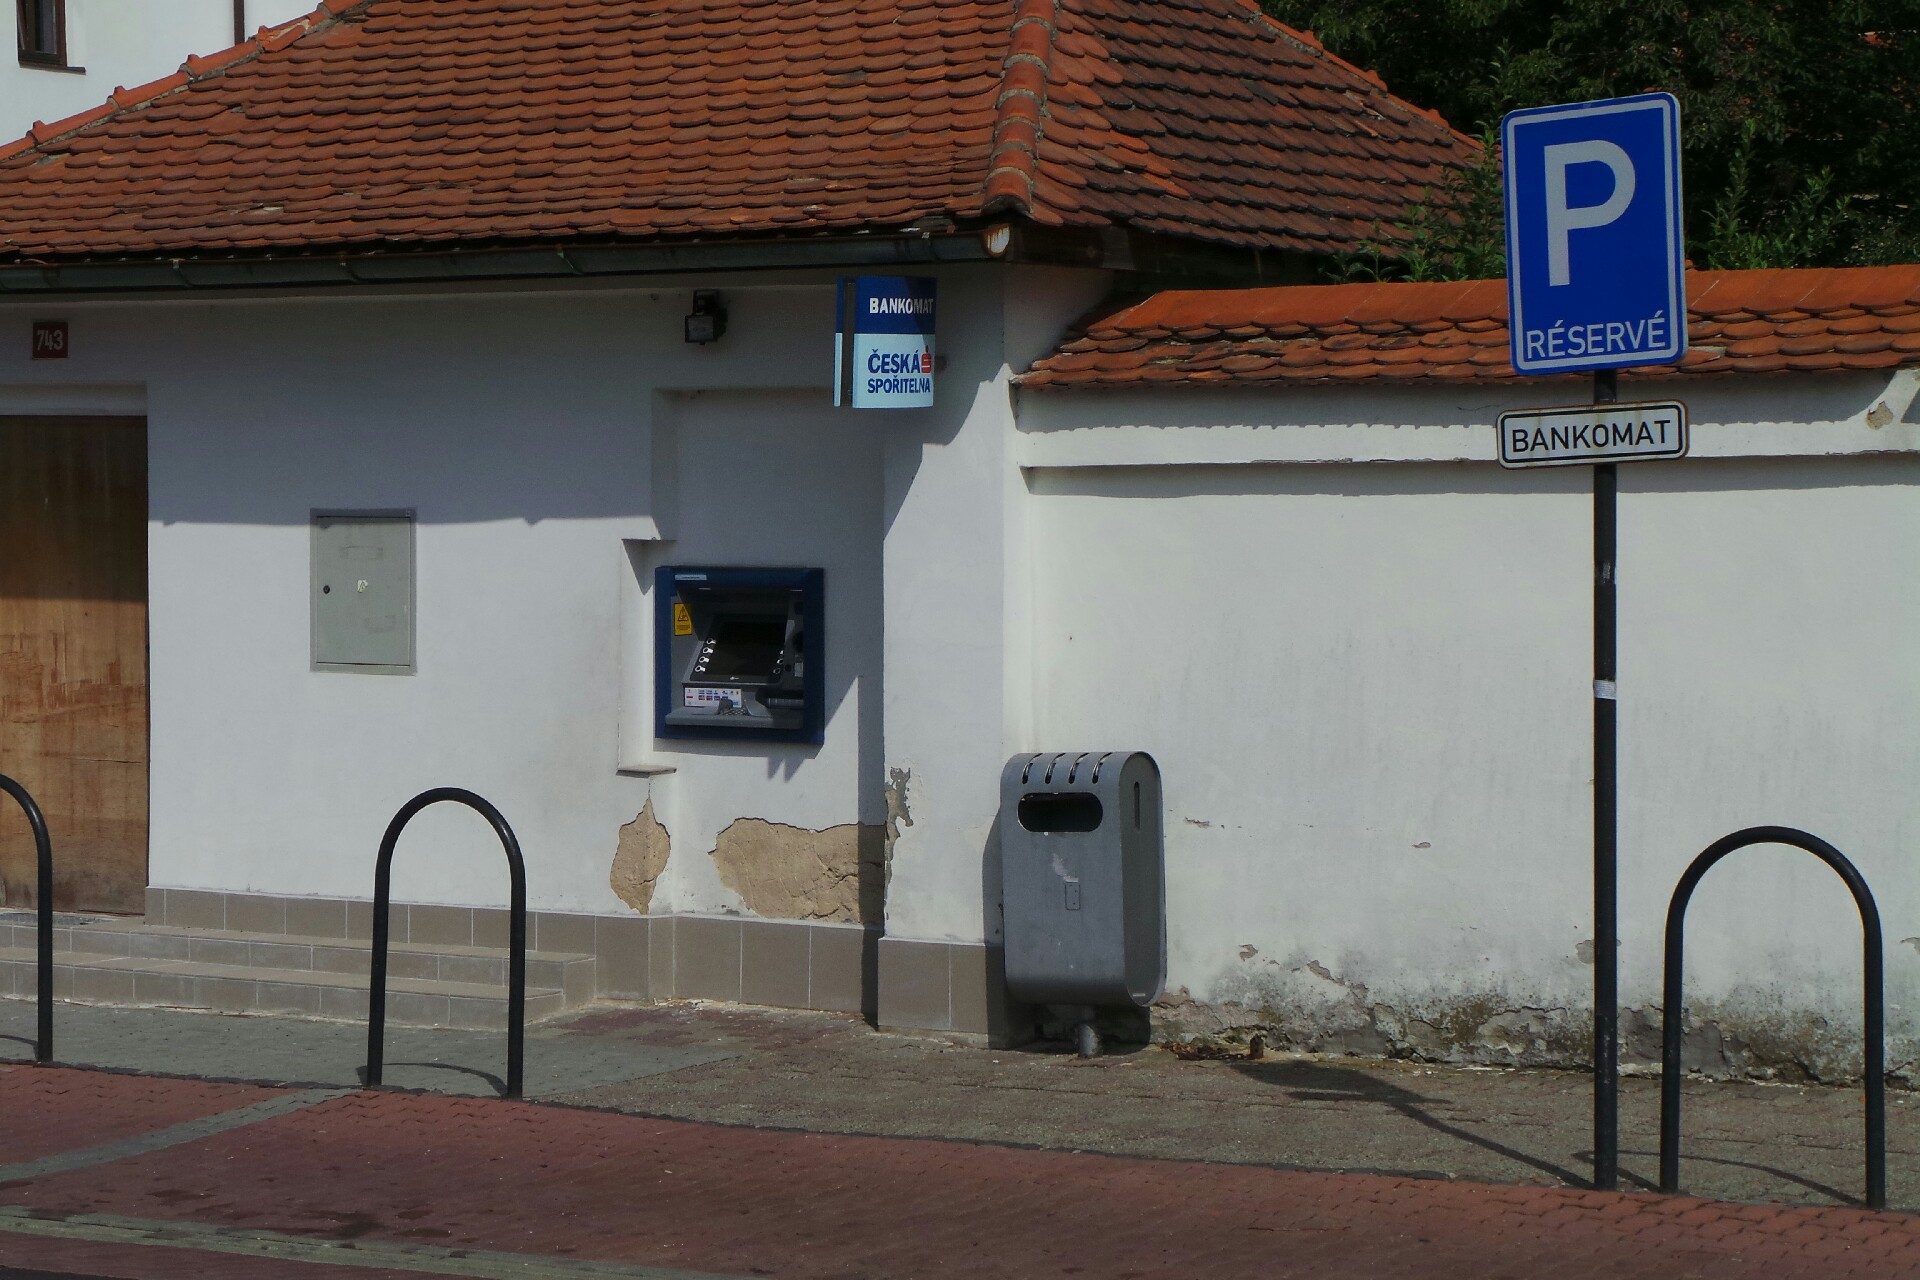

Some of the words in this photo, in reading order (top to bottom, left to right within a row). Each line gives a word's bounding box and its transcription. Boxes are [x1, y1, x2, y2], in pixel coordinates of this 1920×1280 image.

[1543, 139, 1636, 287] P
[869, 297, 934, 314] BANKOMAT
[37, 329, 63, 351] 743
[1526, 310, 1667, 359] RÉSERVÉ
[867, 348, 921, 374] ČESKÁ
[867, 375, 931, 394] SPOŘITELNA
[1511, 419, 1671, 453] BANKOMAT
